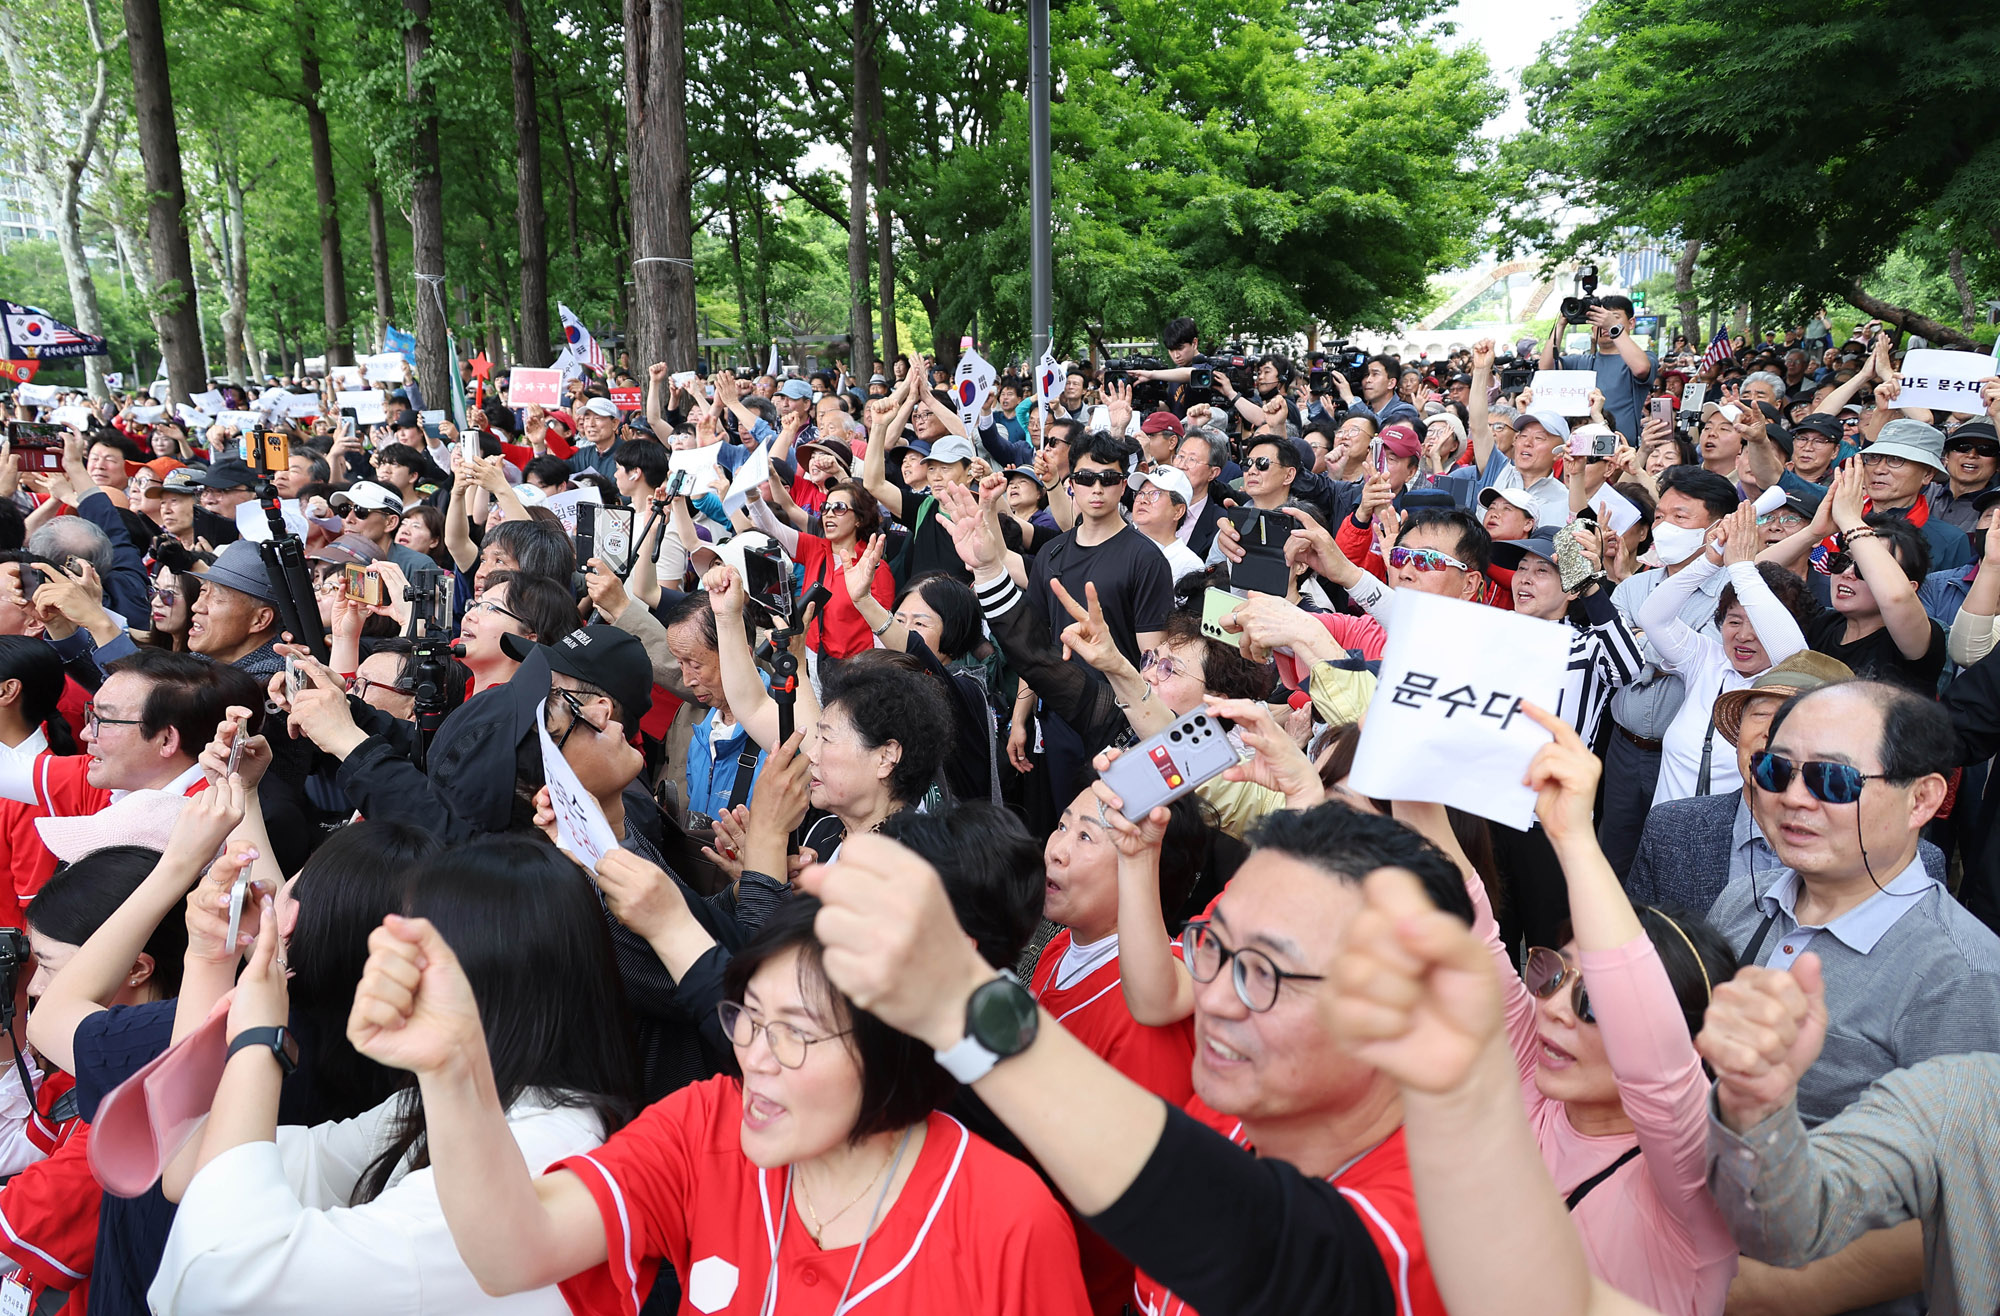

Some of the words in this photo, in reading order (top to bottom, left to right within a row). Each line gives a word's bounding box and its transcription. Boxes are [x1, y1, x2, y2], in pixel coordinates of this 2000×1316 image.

[1535, 386, 1553, 397] 나도
[1559, 387, 1587, 397] 문수다
[1901, 377, 1928, 389] 나도
[1938, 379, 1981, 393] 문수다
[1391, 671, 1523, 730] 문수다
